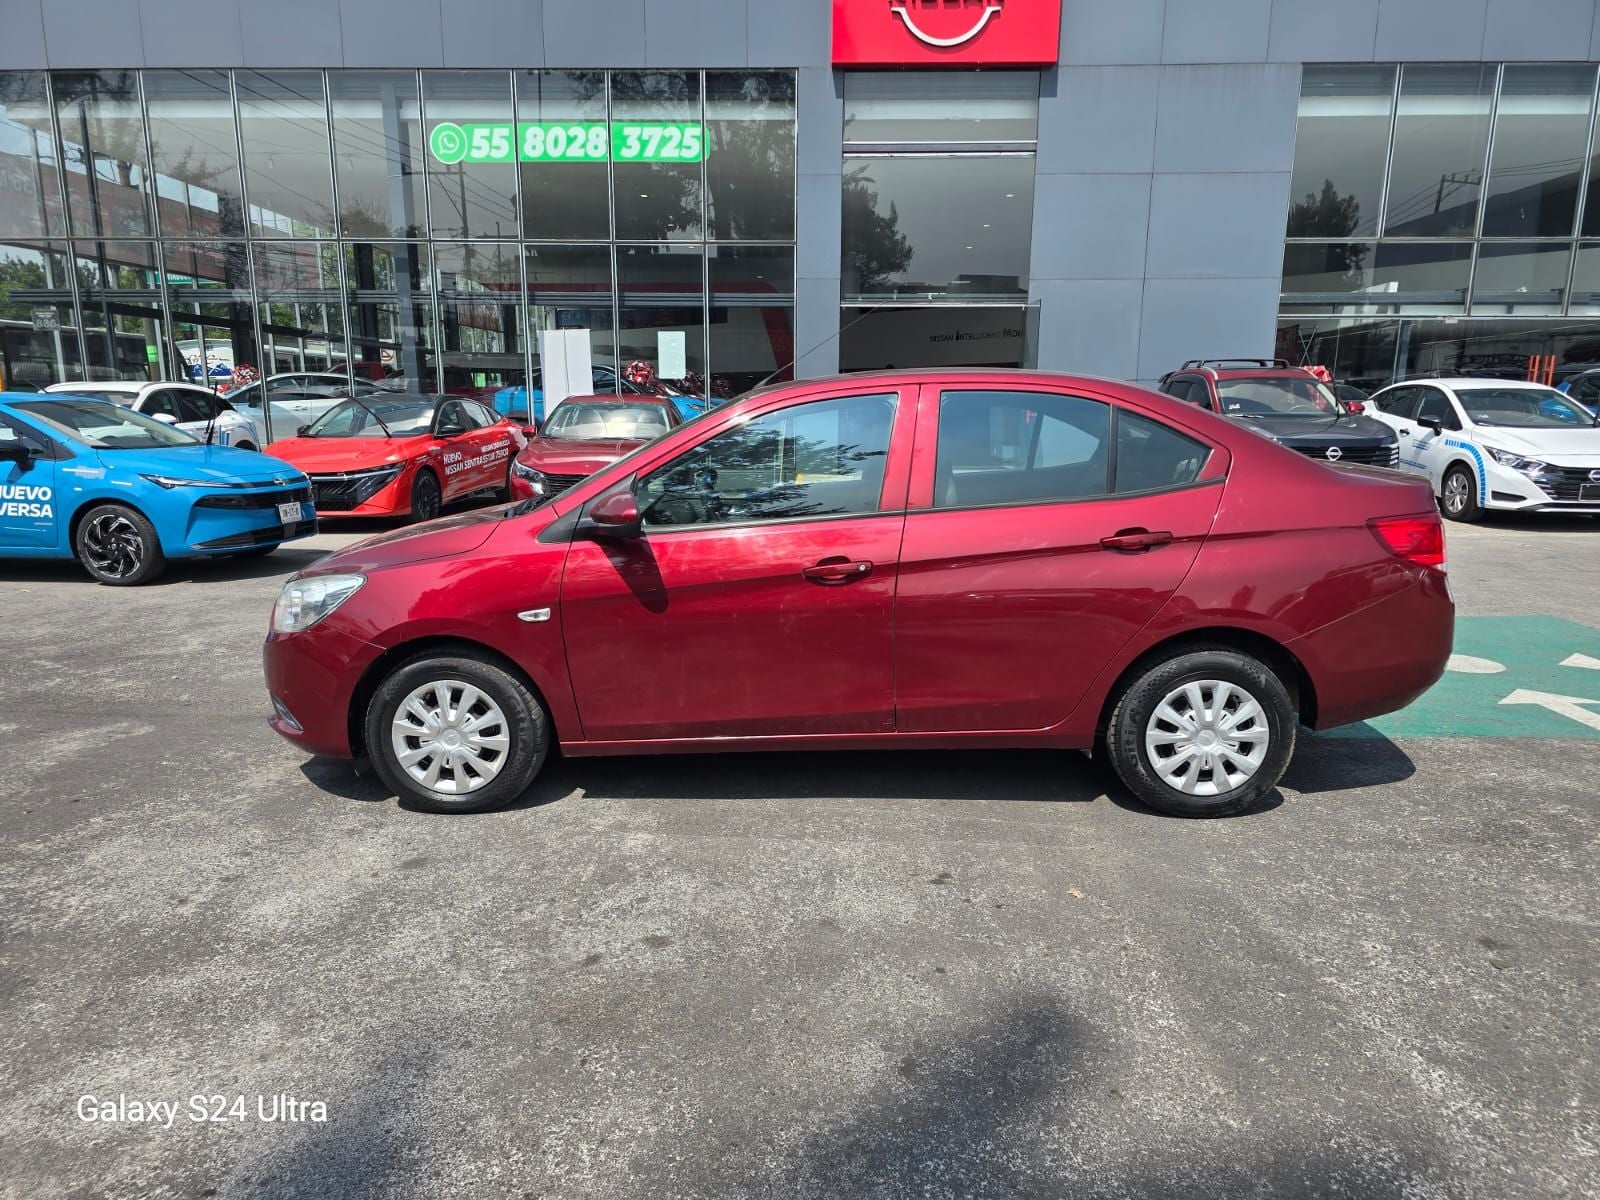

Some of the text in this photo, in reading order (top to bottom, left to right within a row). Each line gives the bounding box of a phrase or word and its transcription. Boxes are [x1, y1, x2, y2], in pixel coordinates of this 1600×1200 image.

[470, 126, 701, 158] 55 8028 3725
[929, 333, 954, 342] NISSAN
[444, 452, 462, 465] NUEVO
[445, 462, 464, 476] NISSAN
[0, 485, 52, 501] UEVO
